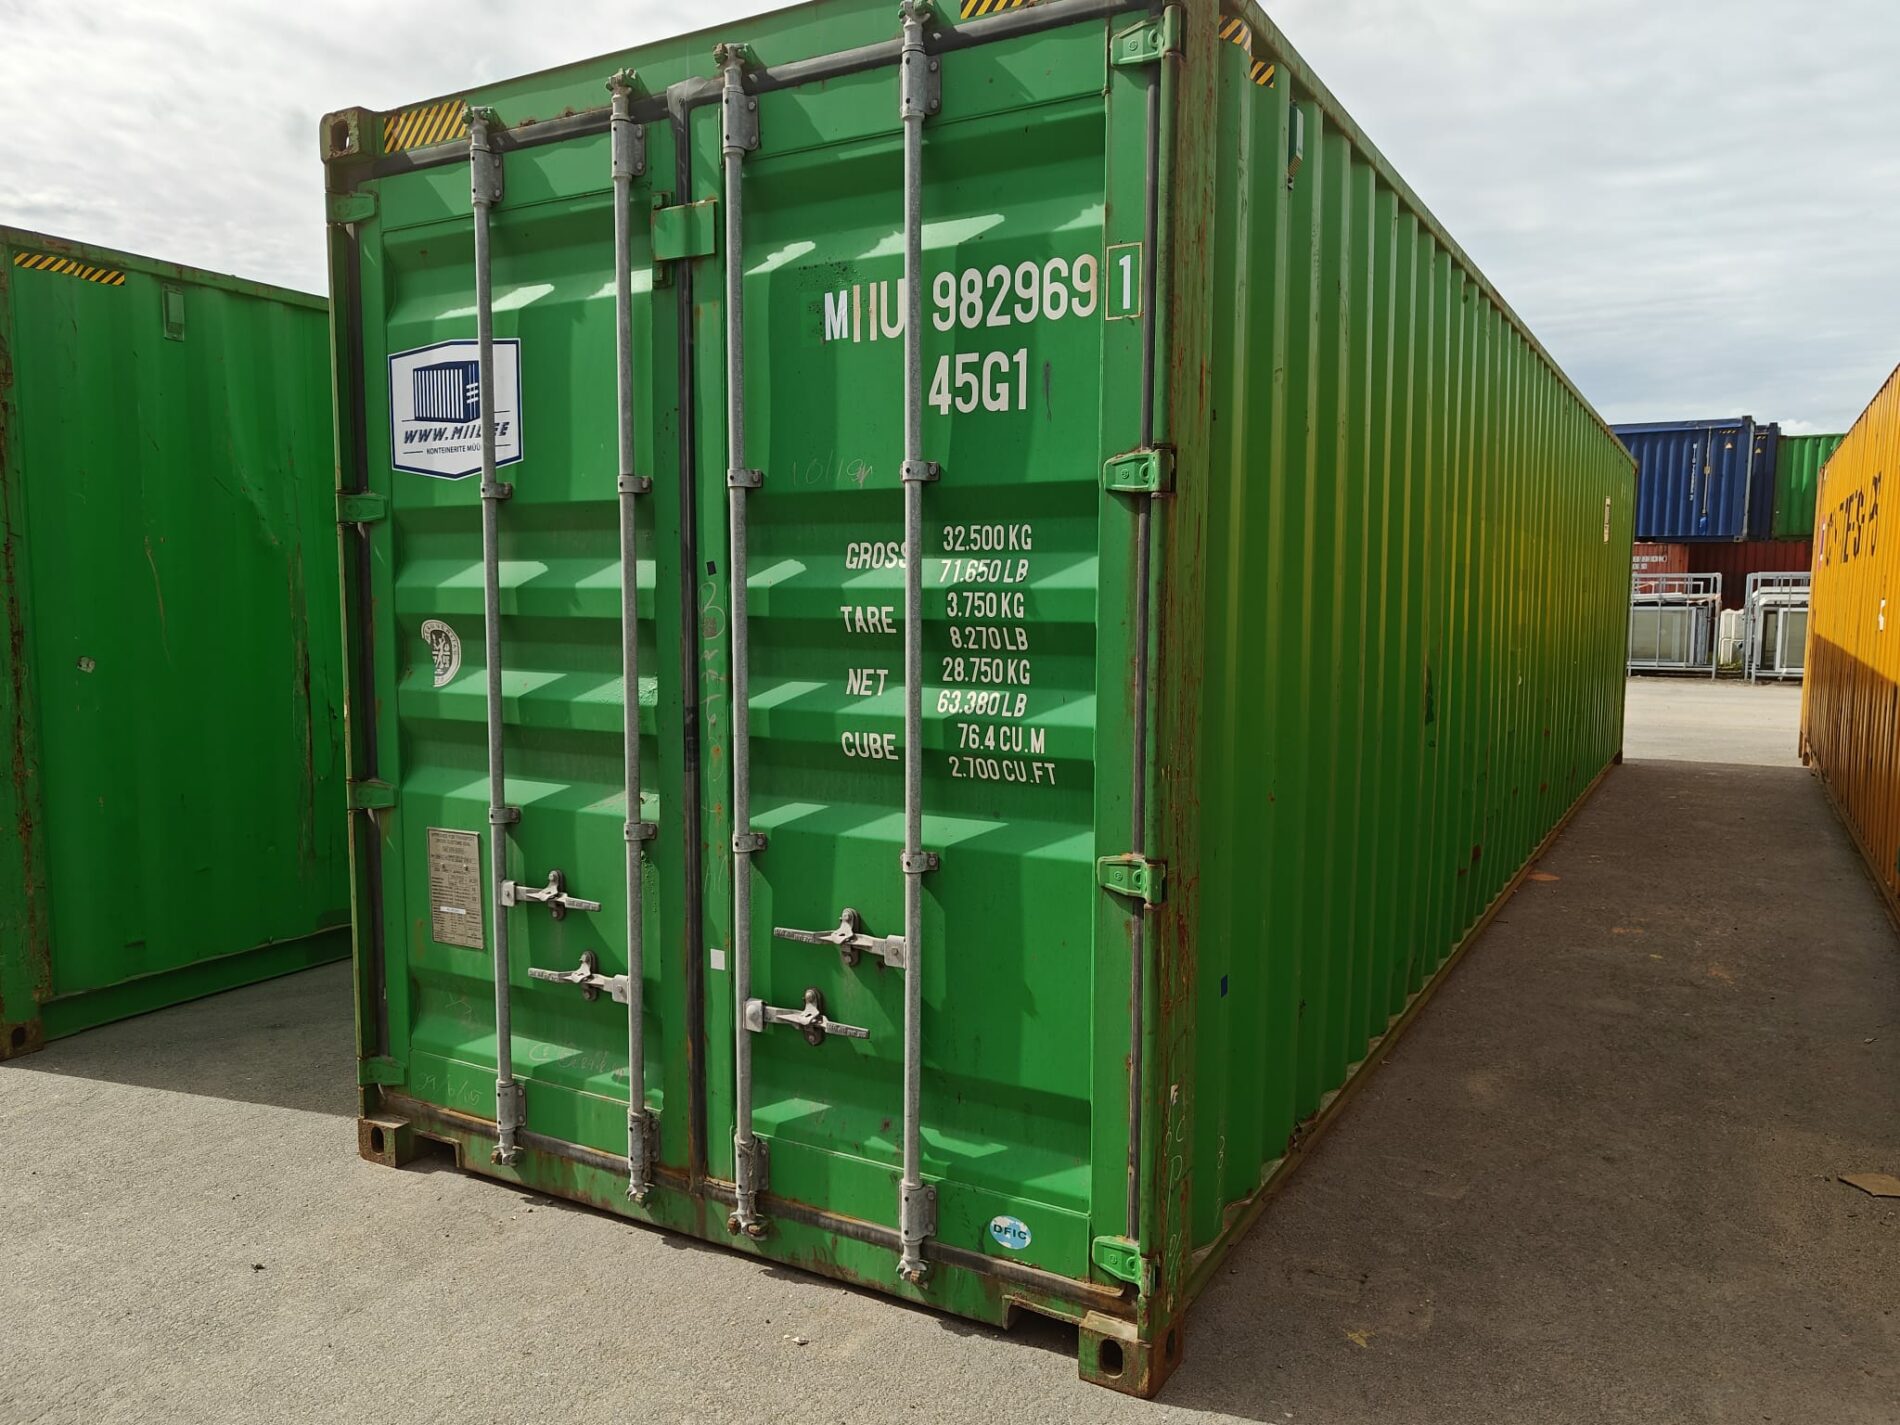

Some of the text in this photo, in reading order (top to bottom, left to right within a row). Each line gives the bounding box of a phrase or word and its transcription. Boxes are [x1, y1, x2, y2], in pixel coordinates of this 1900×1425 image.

[824, 254, 1132, 342] MIIU 982969 1
[928, 348, 1028, 415] 45G1
[426, 445, 466, 455] KONTEINERITE
[943, 524, 1032, 550] 32.500 KG
[939, 559, 1029, 583] 71.650 LB
[947, 592, 1024, 618] 3.750 KG
[841, 606, 897, 634] TARE
[950, 627, 1029, 651] 8.270 LB
[846, 669, 889, 696] NET
[942, 657, 1030, 685] 28.750 KG
[937, 690, 1028, 717] 63.380 LB
[841, 732, 899, 760] CUBE
[957, 723, 1045, 754] 76.4 CU.M
[949, 756, 1056, 785] 2.700 CU.FT
[993, 1224, 1027, 1240] DFIC
